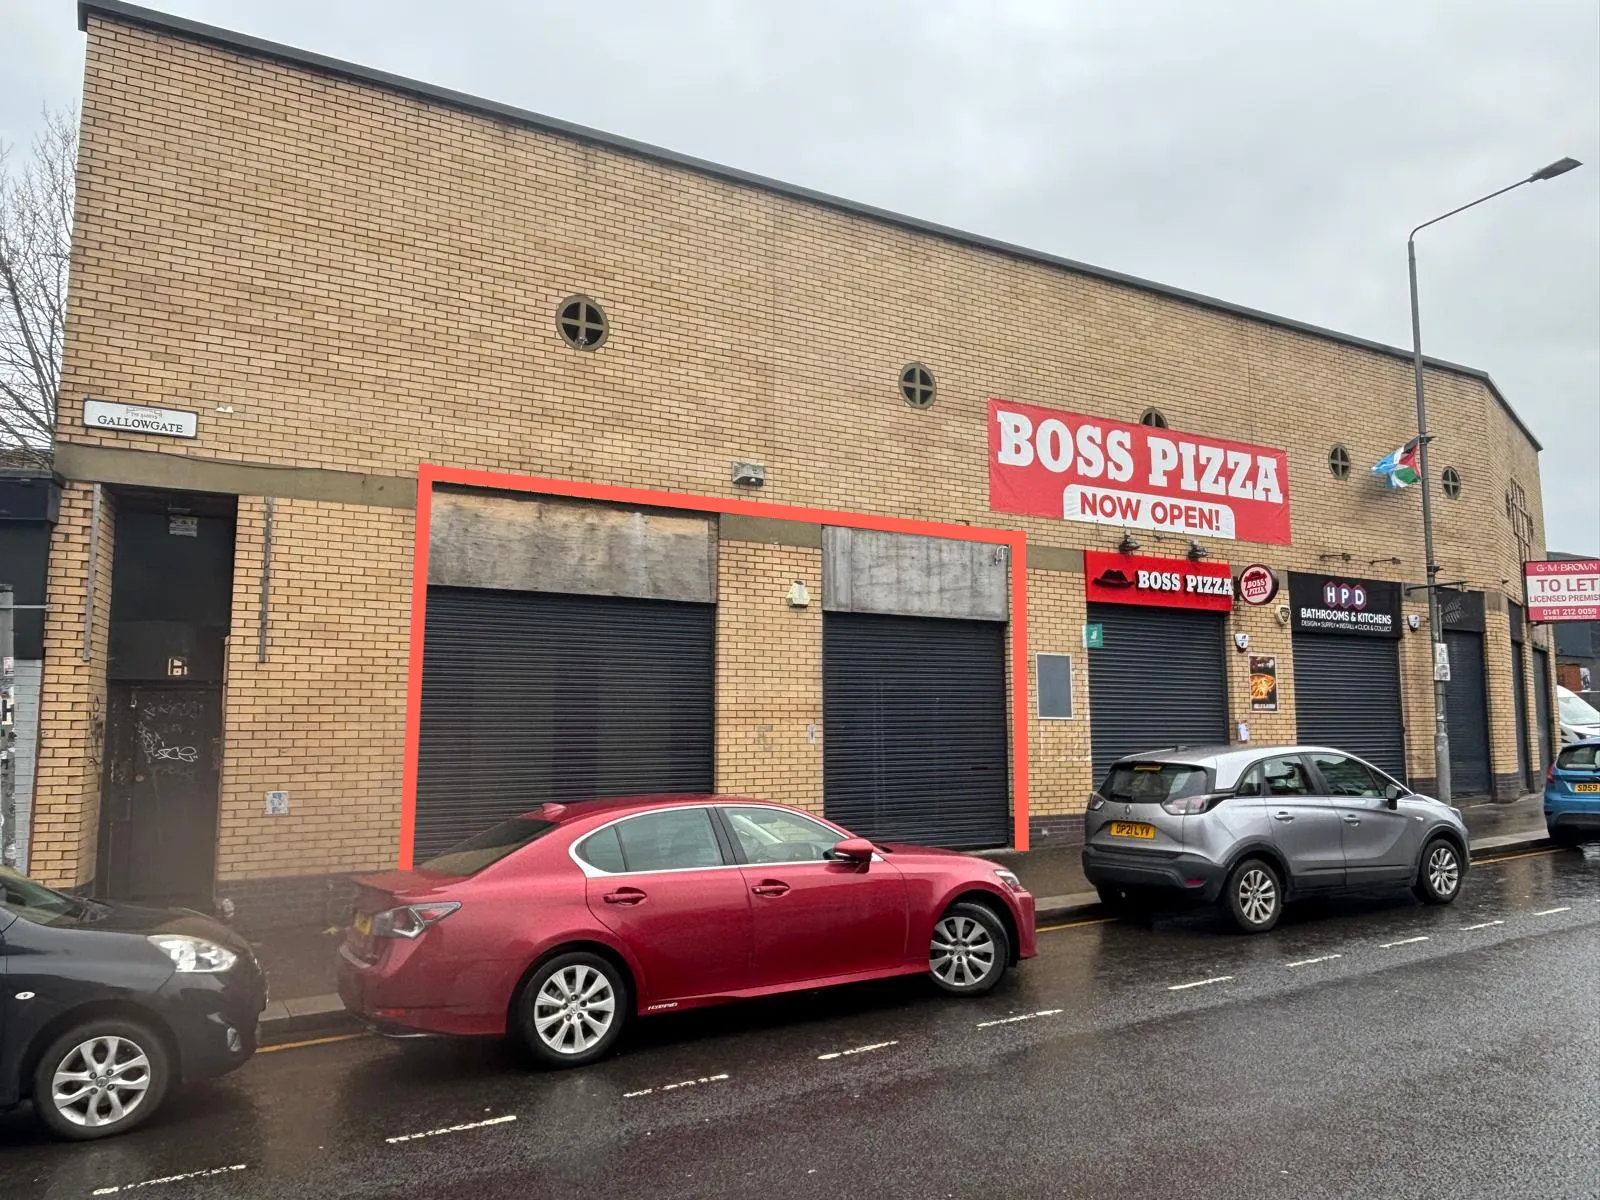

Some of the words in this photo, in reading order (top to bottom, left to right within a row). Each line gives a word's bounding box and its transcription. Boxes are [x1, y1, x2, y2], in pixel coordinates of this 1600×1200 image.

[97, 415, 183, 433] GALLOWGATE
[996, 410, 1134, 482] BOSS
[1147, 435, 1283, 504] PIZZA
[1080, 492, 1141, 521] NOW
[1151, 501, 1220, 531] OPEN!
[1137, 570, 1181, 591] BOSS
[1185, 574, 1234, 596] PIZZA
[1247, 579, 1266, 589] BOSS
[1536, 579, 1561, 592] TO
[1566, 578, 1599, 592] LET
[1248, 587, 1266, 596] PIZZA
[1529, 594, 1567, 603] LICENSED
[1301, 607, 1350, 622] BATHROOMS
[1350, 612, 1357, 622] &
[1357, 612, 1392, 625] KITCHENS
[1542, 608, 1560, 616] 0141
[1562, 608, 1577, 616] 212
